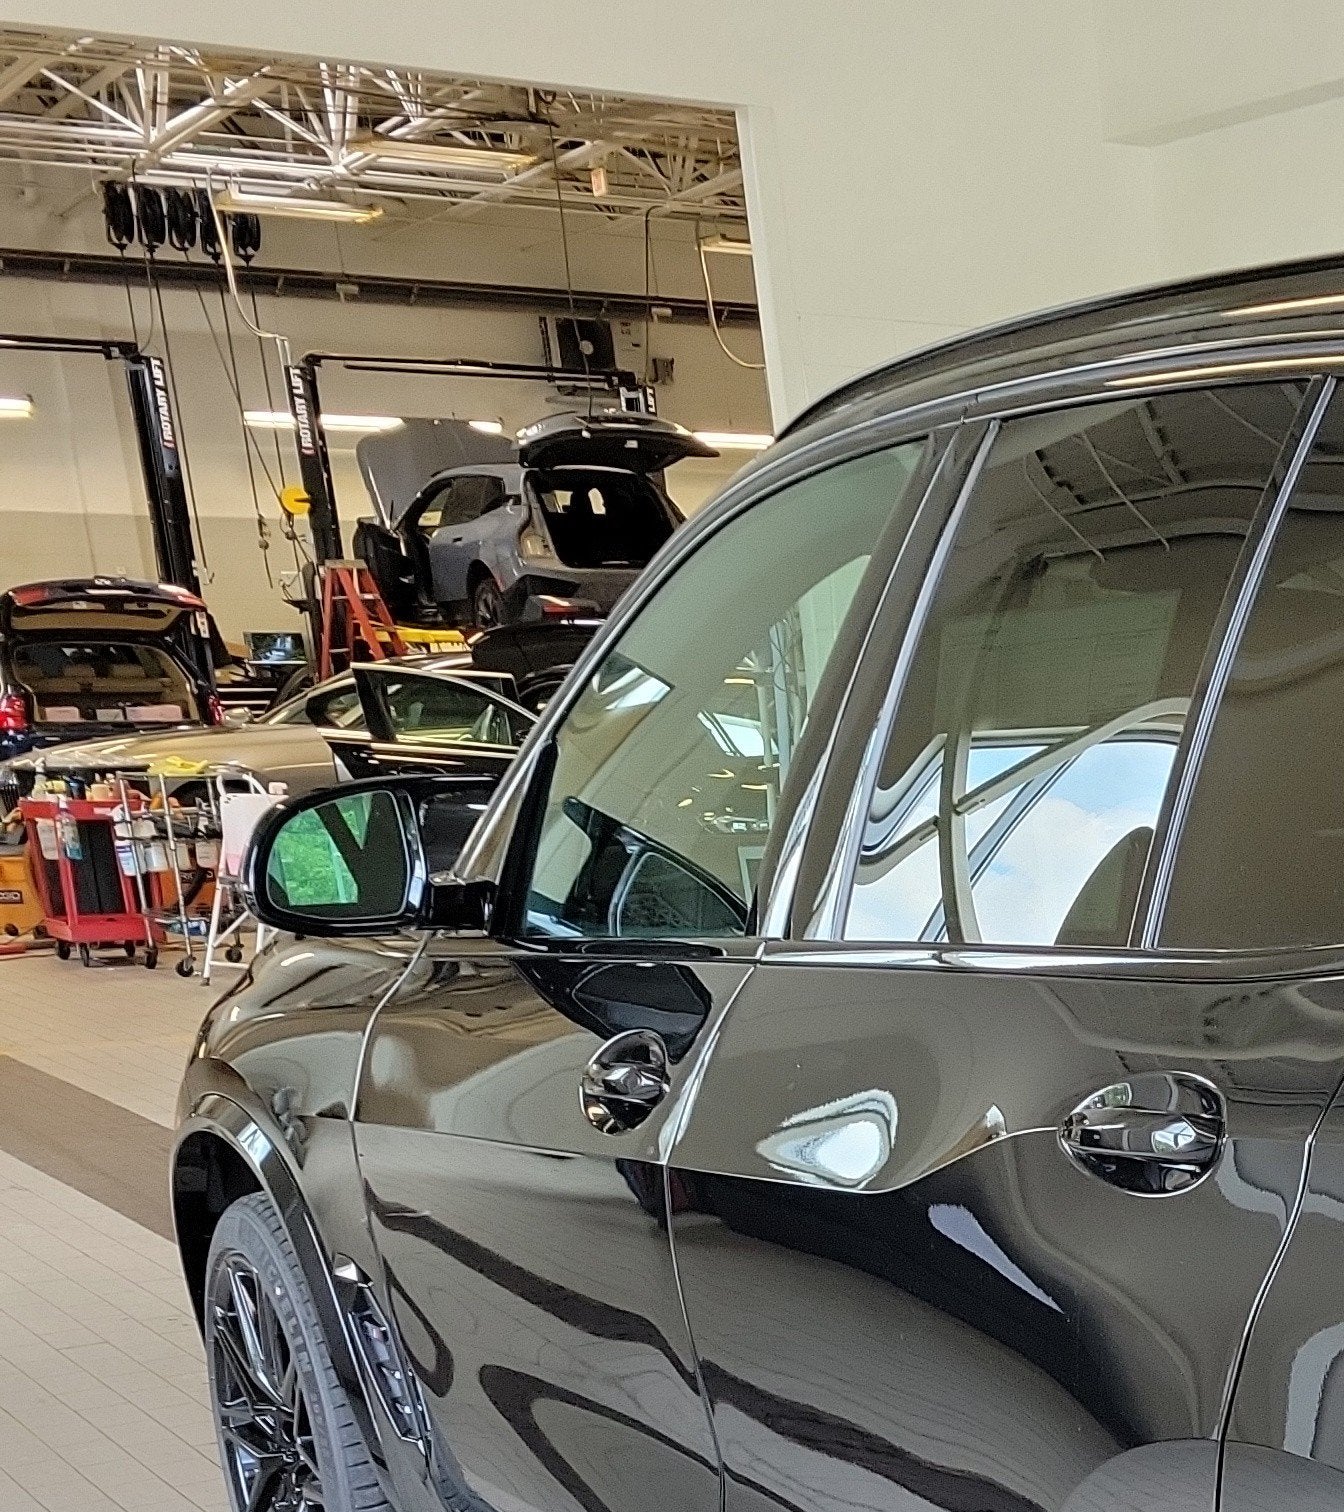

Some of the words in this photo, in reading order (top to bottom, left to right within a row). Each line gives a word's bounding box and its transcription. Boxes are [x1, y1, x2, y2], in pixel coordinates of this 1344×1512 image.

[150, 357, 165, 387] LIFT
[289, 367, 304, 395] LIFT
[156, 388, 174, 441] ROTARY
[294, 396, 313, 448] ROTARY
